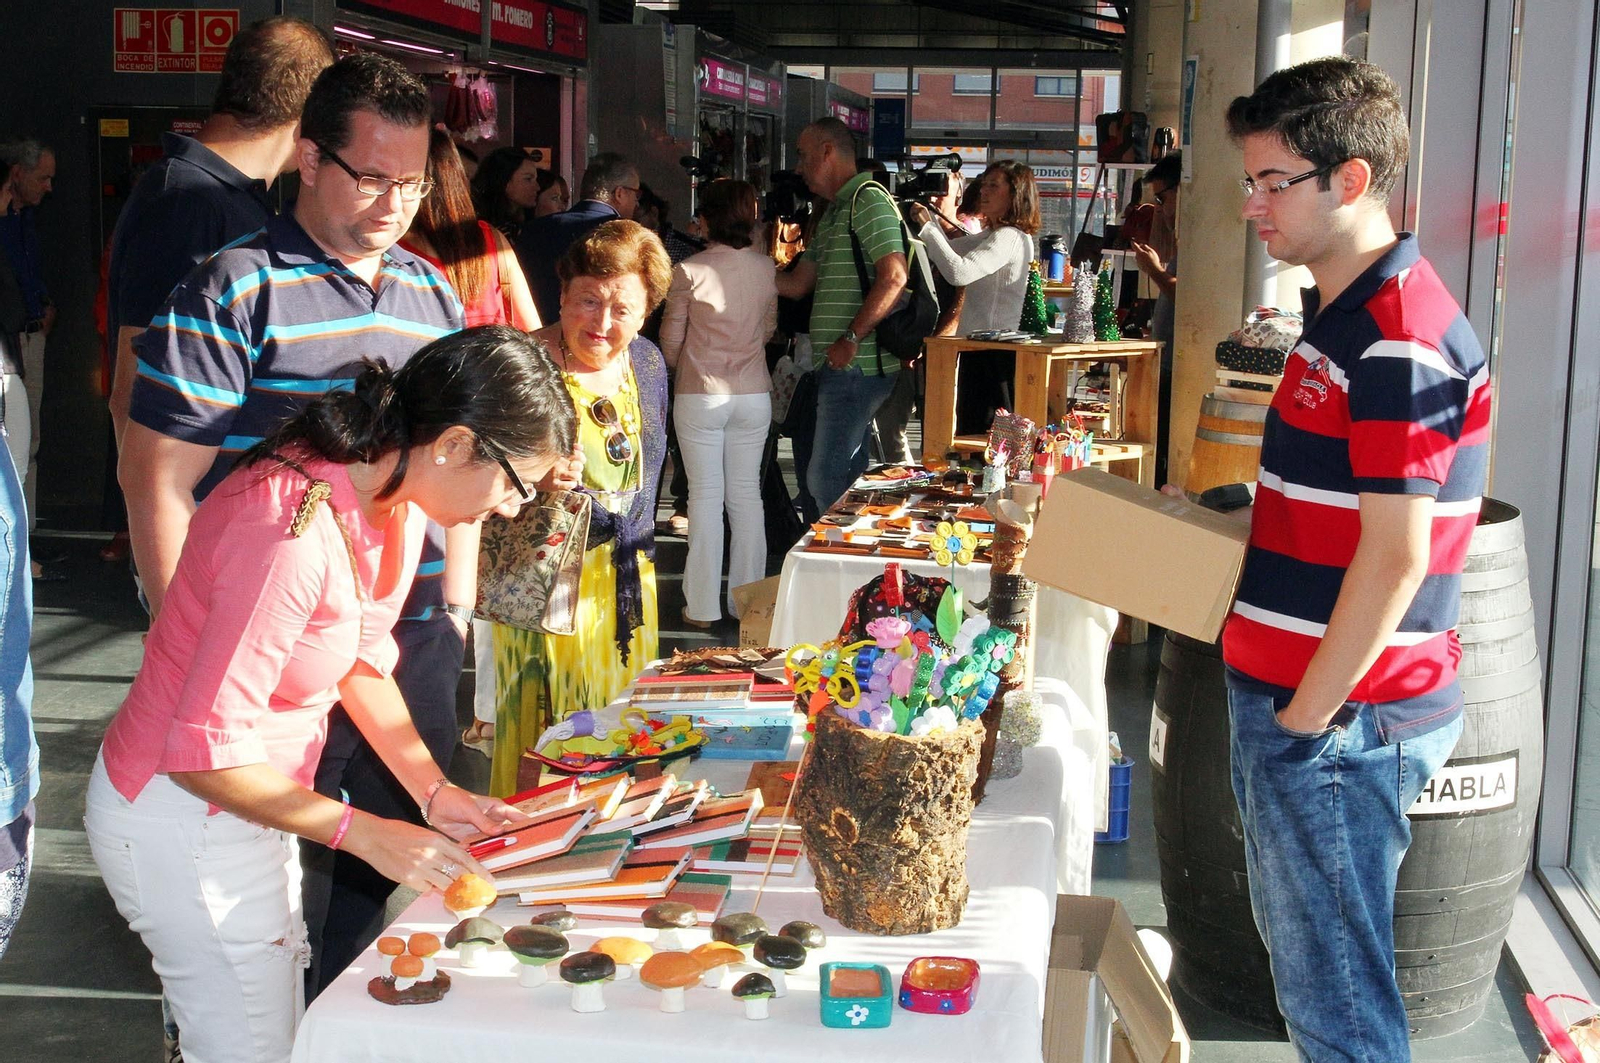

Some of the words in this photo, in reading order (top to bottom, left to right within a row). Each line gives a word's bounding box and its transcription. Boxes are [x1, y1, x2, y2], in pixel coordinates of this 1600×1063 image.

[117, 54, 139, 62] BOCA
[117, 63, 154, 71] INCENDIO
[158, 58, 196, 69] EXTINTOR
[173, 121, 202, 129] CONTINENTAL
[1416, 773, 1507, 804] HABLA
